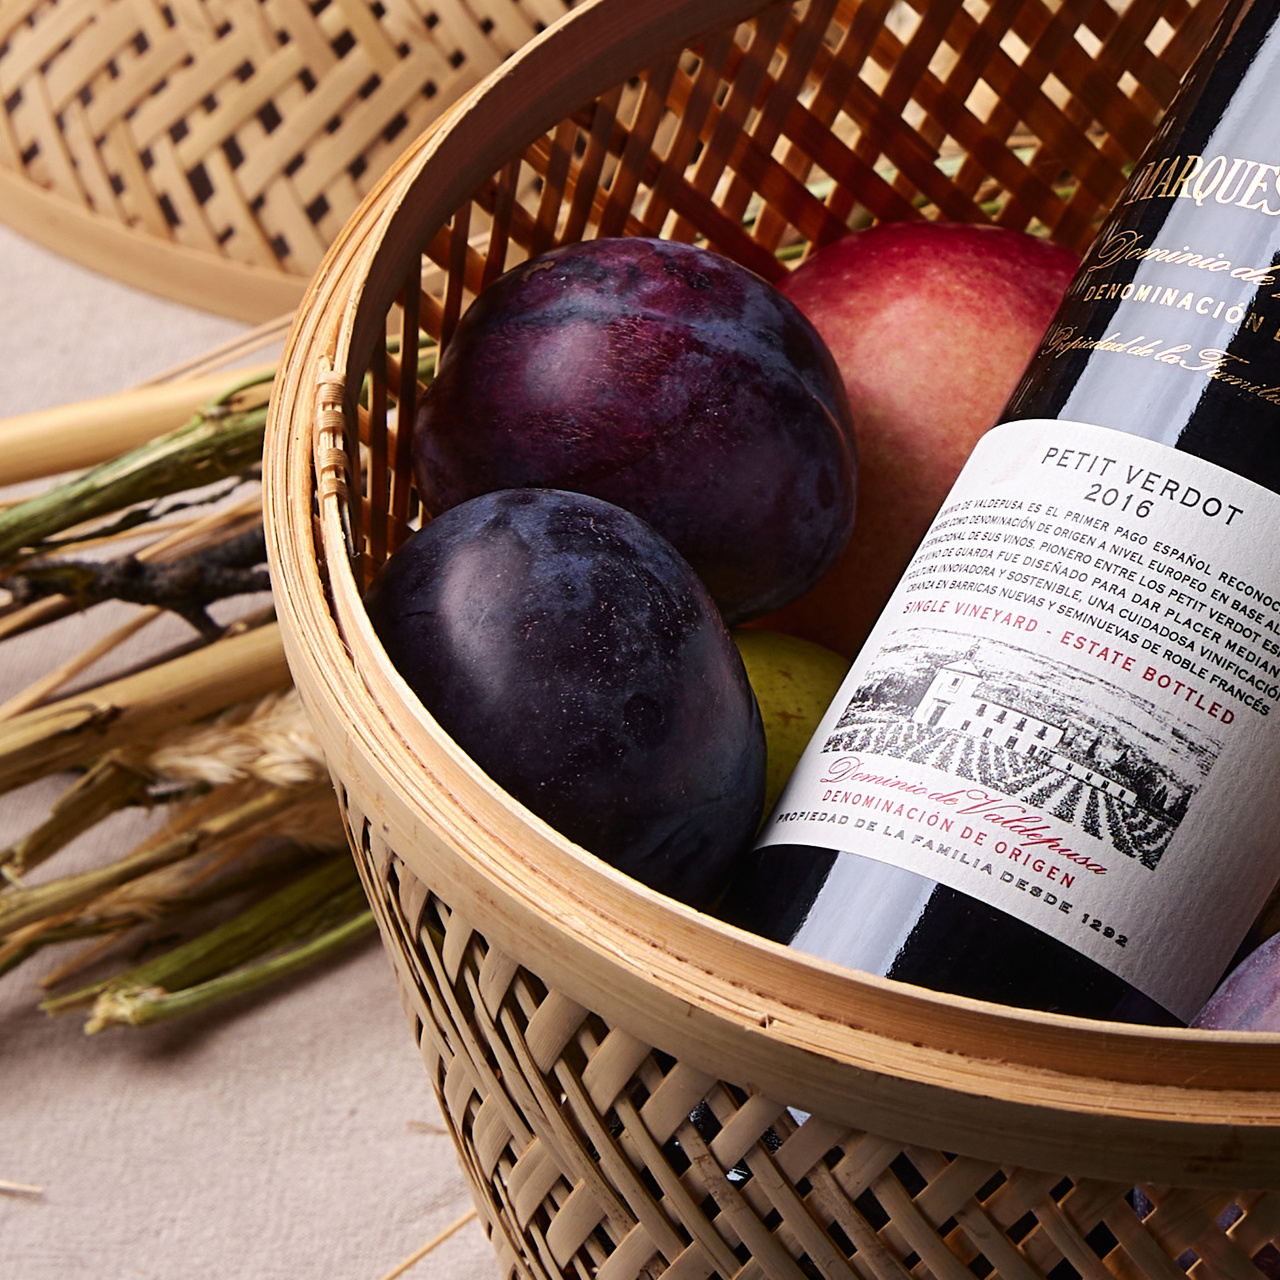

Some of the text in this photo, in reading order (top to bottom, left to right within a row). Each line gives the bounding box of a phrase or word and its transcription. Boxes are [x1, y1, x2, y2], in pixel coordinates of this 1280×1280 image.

[1088, 231, 1231, 272] Dominio
[1083, 283, 1264, 333] DENOMINACIÓN
[1126, 340, 1163, 357] de
[1041, 447, 1244, 525] PETIT VERDOT
[1083, 483, 1154, 518] 2016
[961, 500, 973, 510] DE
[974, 499, 1023, 510] VALDEPUSA
[1027, 502, 1042, 513] ES
[1045, 506, 1058, 517] EL
[1064, 510, 1110, 532] PRIMER
[1113, 526, 1148, 545] PAGO
[1152, 541, 1212, 575] ESPAÑOL
[968, 515, 1036, 530] DENOMINACIÓN
[1036, 522, 1052, 533] DE
[1053, 526, 1097, 546] ORIGEN
[1097, 540, 1107, 551] A
[1109, 544, 1144, 565] NIVEL
[1148, 559, 1207, 592] EUROPEO
[1210, 589, 1230, 604] EN
[1231, 599, 1265, 625] BASE
[1264, 619, 1280, 636] AL
[937, 563, 995, 576] INNOVADORA
[998, 569, 1008, 578] Y
[1007, 571, 1082, 603] SOSTENIBLE,
[1087, 595, 1115, 614] UNA
[1118, 608, 1195, 651] CUIDADOSA
[942, 548, 955, 557] DE
[955, 547, 993, 559] GUARDA
[996, 551, 1020, 565] FUE
[1022, 556, 1088, 582] DISEÑADO
[1092, 577, 1126, 598] PARA
[1131, 593, 1161, 613] DAR
[1164, 608, 1222, 644] PLACER
[967, 531, 981, 540] DE
[981, 531, 1001, 542] SUS
[1039, 541, 1092, 564] PIONERO
[1094, 559, 1138, 582] ENTRE
[1138, 575, 1166, 594] LOS
[1168, 589, 1207, 613] PETIT
[1209, 608, 1262, 643] VERDOT
[903, 600, 950, 614] SINGLE
[954, 602, 1039, 632] VINEYARD
[1060, 630, 1136, 672] ESTATE
[1142, 666, 1235, 724] BOTTLED
[935, 579, 949, 589] EN
[949, 579, 998, 594] BARRICAS
[999, 588, 1046, 607] NUEVAS
[1047, 601, 1056, 610] Y
[1057, 604, 1140, 644] SEMINUEVAS
[1141, 638, 1161, 655] DE
[1163, 649, 1209, 679] ROBLE
[1209, 674, 1271, 716] FRANCÉS
[820, 756, 1108, 875] Dominio de Valdepusa
[822, 789, 1075, 889] DENOMINACIÓN DE ORIGEN
[776, 811, 1129, 948] PROPIEDAD DE LA FAMILIA DESDE 1292
